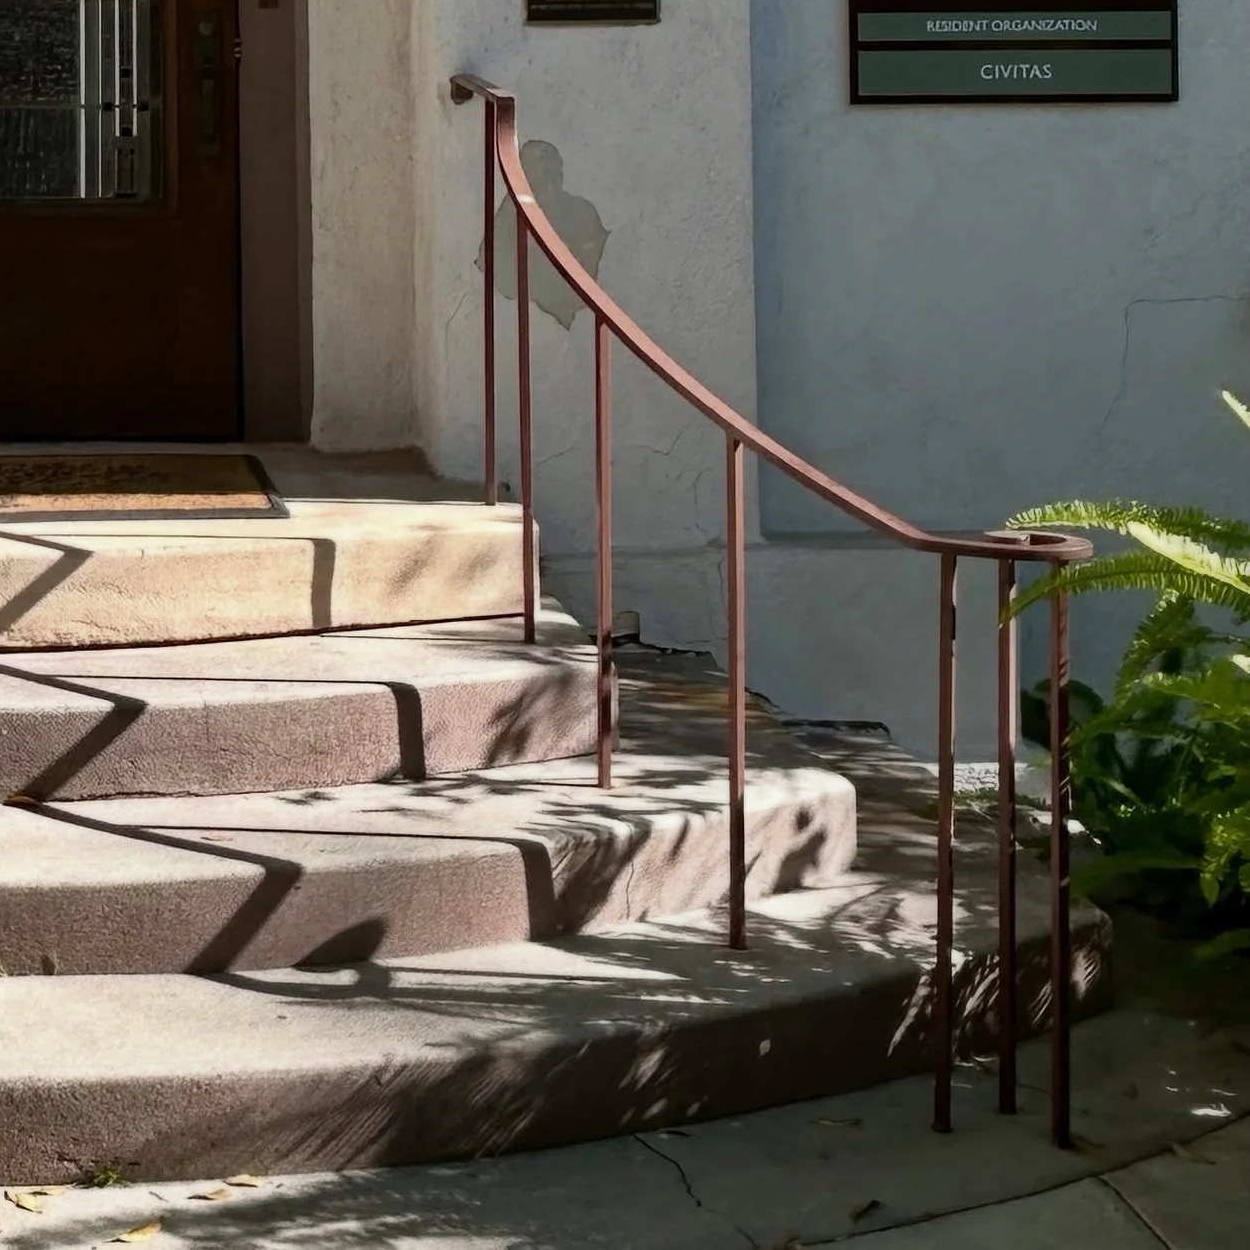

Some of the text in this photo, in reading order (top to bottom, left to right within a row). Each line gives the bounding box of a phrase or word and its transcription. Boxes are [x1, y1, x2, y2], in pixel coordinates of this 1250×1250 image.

[926, 20, 1097, 32] RESIDENT ORGANIZATION
[980, 64, 1052, 79] CIVITAS
